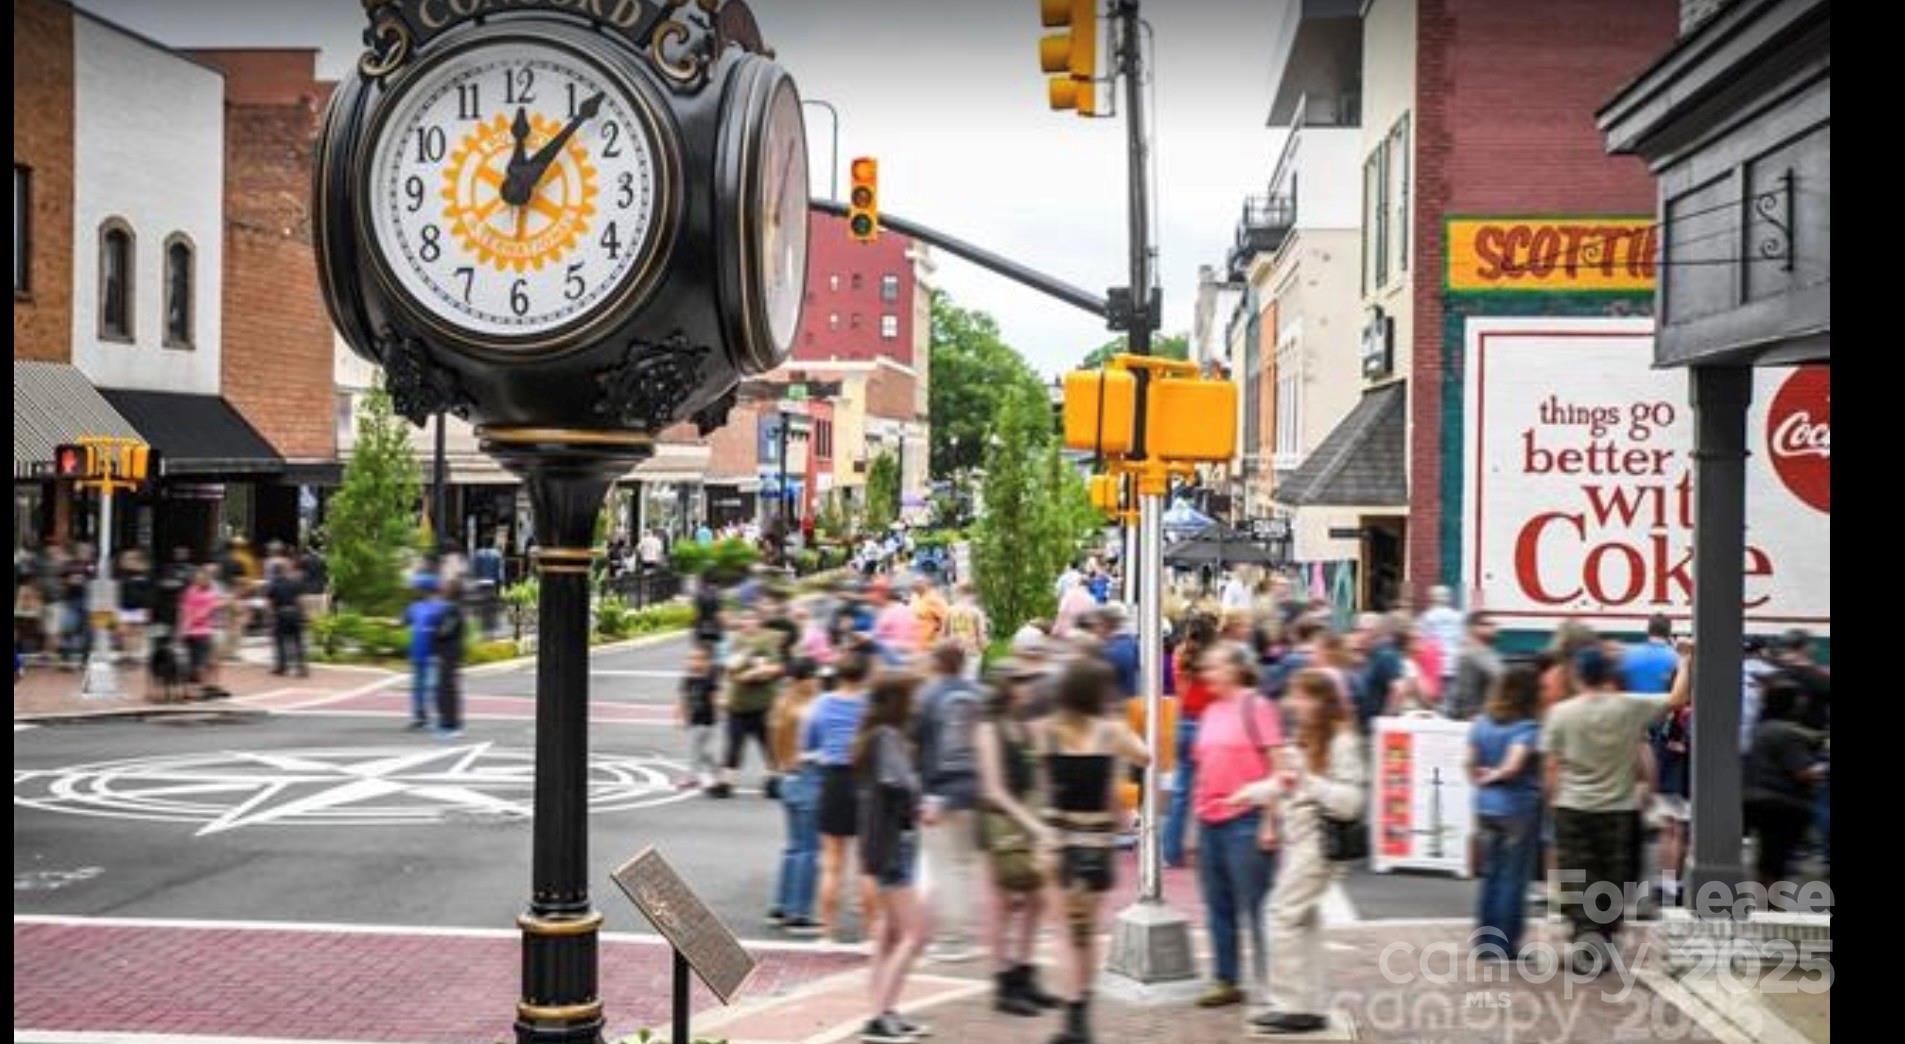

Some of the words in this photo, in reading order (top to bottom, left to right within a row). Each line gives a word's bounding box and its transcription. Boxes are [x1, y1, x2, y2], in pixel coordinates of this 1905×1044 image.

[419, 0, 642, 28] CORD
[457, 83, 481, 120] 11
[504, 68, 537, 105] 12
[565, 83, 576, 119] 1
[416, 126, 446, 164] 10
[601, 120, 622, 158] 2
[405, 176, 425, 213] 9
[617, 172, 635, 209] 3
[419, 225, 441, 263] 8
[600, 221, 622, 260] 4
[453, 267, 475, 306] 7
[510, 279, 530, 316] 6
[564, 261, 586, 300] 5
[1540, 394, 1621, 438] things
[1628, 401, 1675, 441] go
[1522, 427, 1674, 476] better
[1581, 469, 1695, 530] wit
